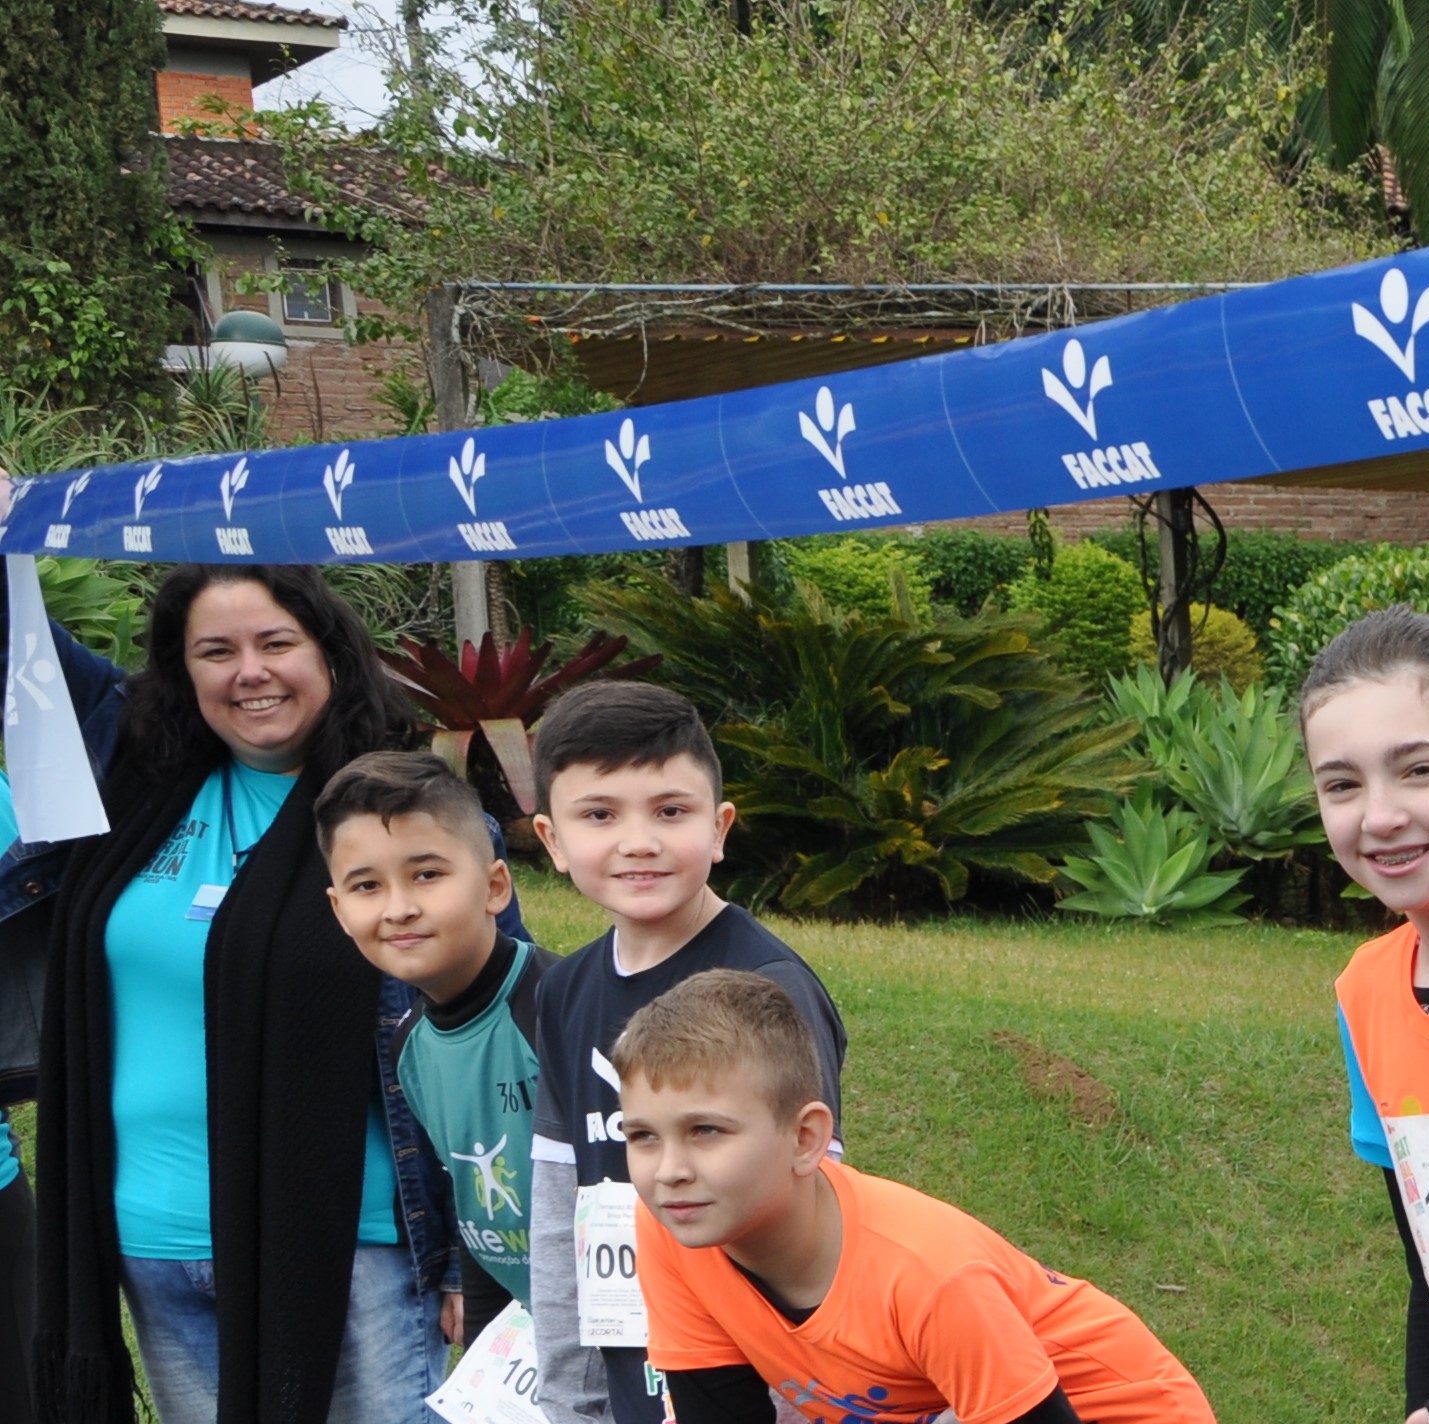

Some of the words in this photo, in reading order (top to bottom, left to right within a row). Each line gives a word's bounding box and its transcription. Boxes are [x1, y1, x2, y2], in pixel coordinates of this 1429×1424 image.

[1061, 441, 1161, 489] FACCAT
[818, 481, 902, 522] FACCAT
[215, 527, 254, 556] FACCAT
[325, 526, 374, 556] FACCAT
[457, 521, 517, 551] FACCAT
[619, 507, 690, 542] FACCAT
[586, 1243, 637, 1279] 100
